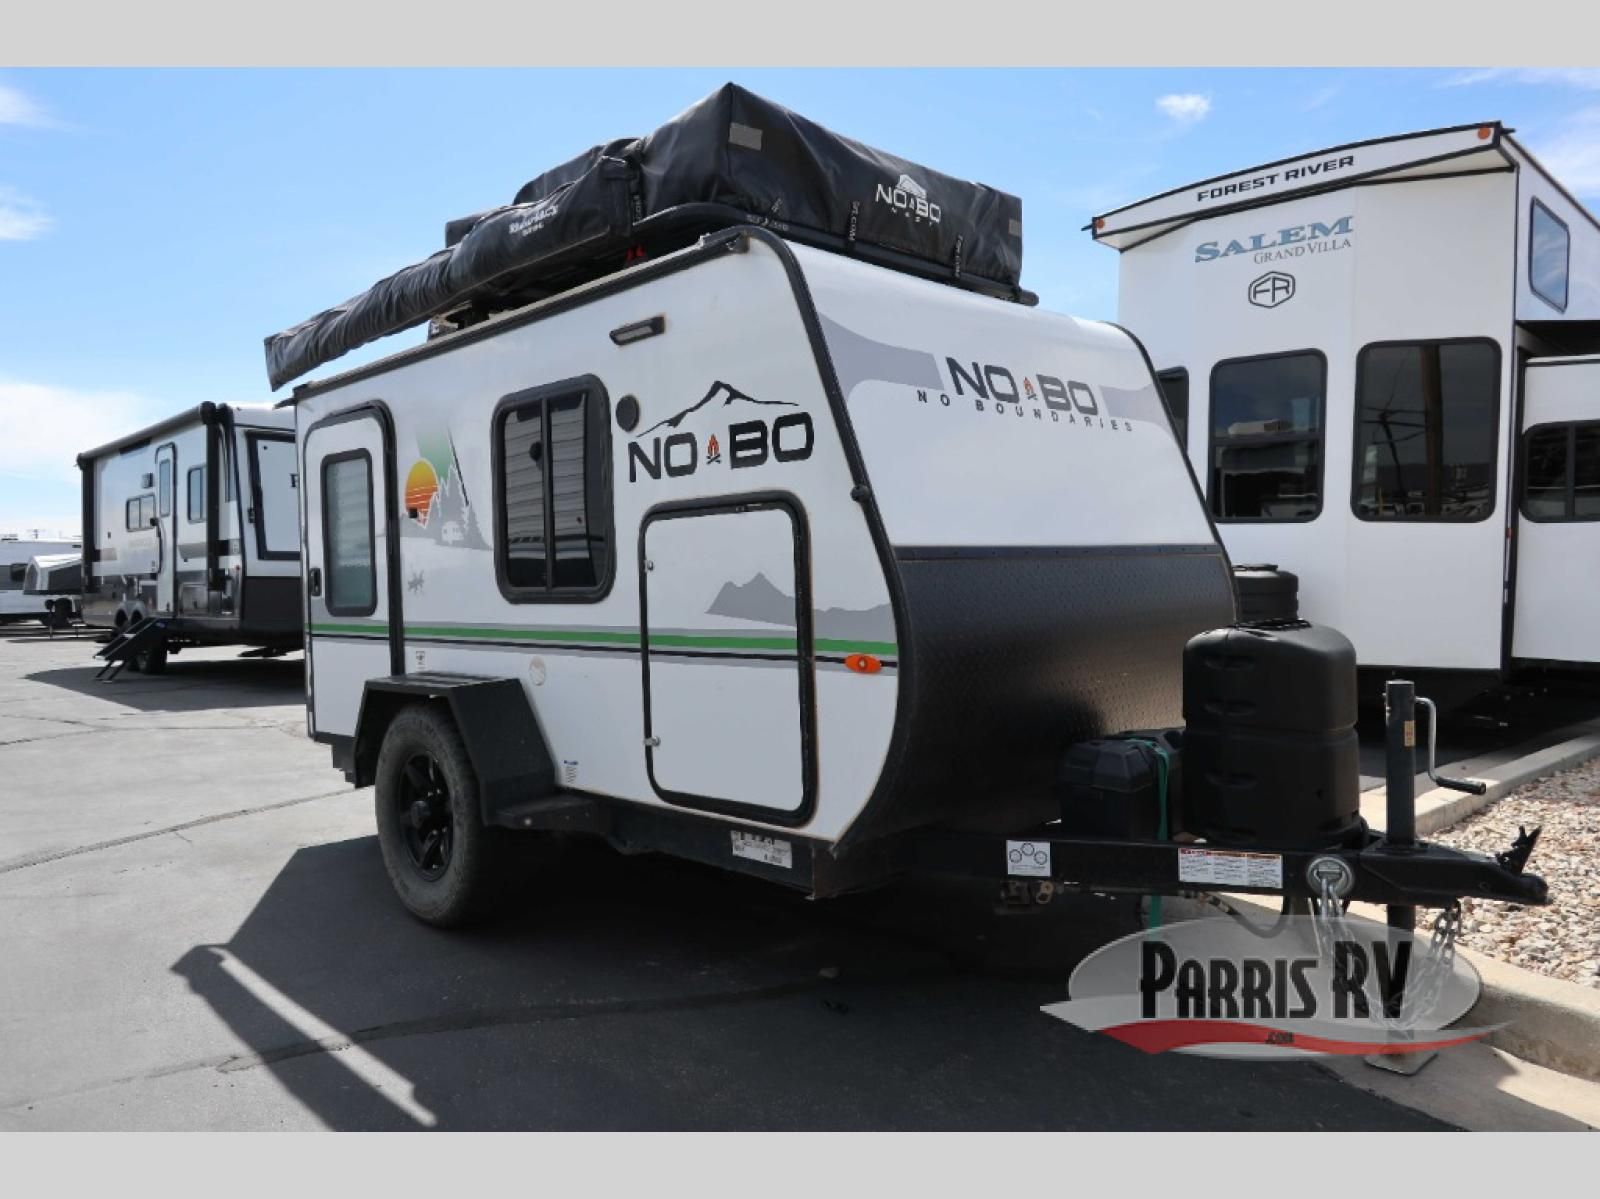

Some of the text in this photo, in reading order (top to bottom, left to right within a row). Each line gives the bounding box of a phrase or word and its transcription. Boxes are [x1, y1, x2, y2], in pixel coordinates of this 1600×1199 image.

[1197, 155, 1354, 201] FOREST RIVER
[1195, 216, 1354, 263] SALEM
[1253, 238, 1352, 265] GRAND VILLA
[1253, 276, 1291, 303] FR
[916, 389, 1133, 432] NO BOUNDARIES
